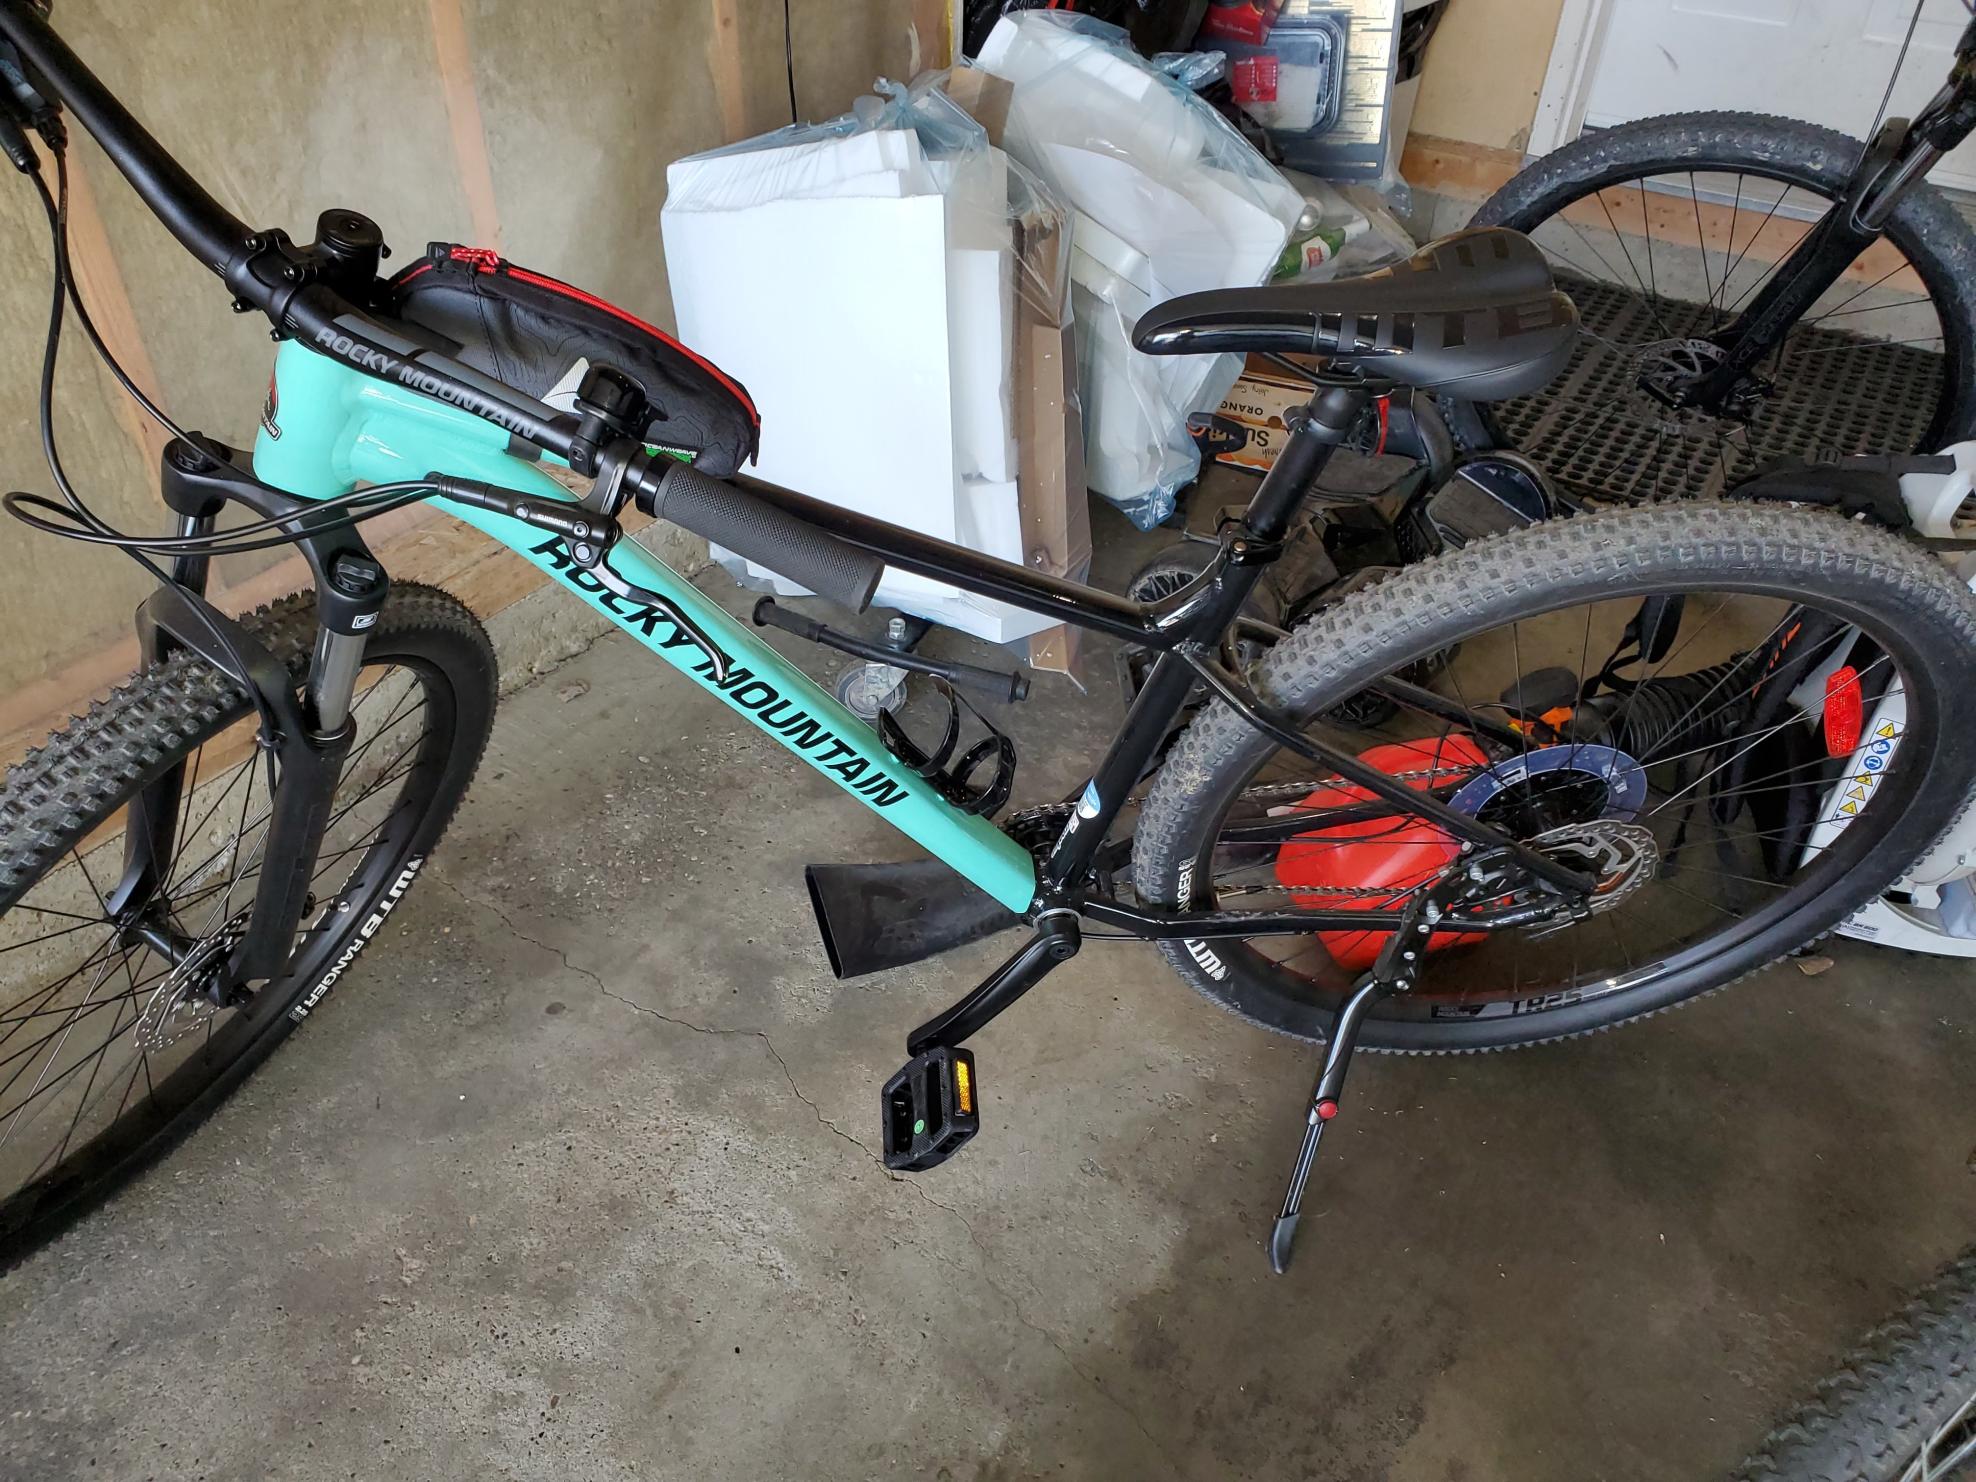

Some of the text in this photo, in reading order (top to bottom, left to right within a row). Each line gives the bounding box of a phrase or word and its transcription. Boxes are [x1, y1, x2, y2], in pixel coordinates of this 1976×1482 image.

[315, 326, 538, 439] ROCKY MOUNTAIN
[1220, 400, 1264, 416] ORANG
[691, 652, 910, 808] MOUNTAIN
[1177, 867, 1193, 914] ANGER
[303, 938, 365, 1008] RANGER
[1184, 940, 1222, 975] WT
